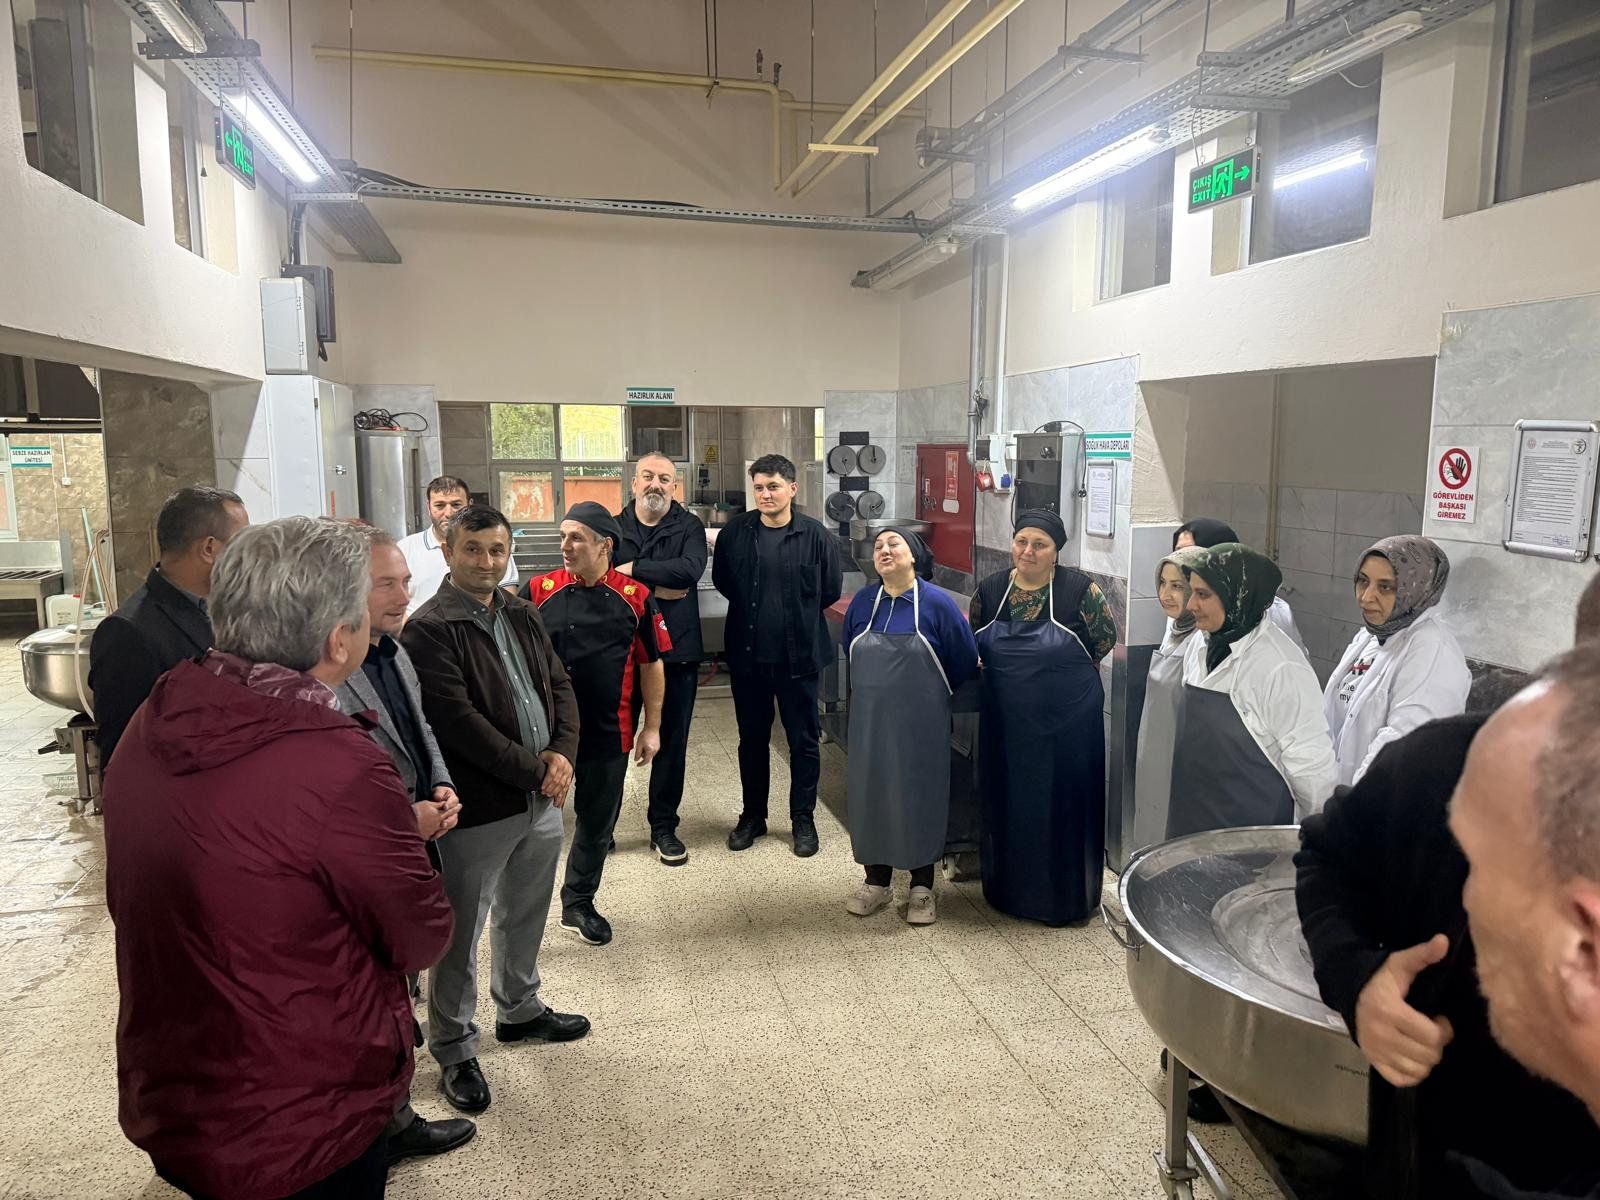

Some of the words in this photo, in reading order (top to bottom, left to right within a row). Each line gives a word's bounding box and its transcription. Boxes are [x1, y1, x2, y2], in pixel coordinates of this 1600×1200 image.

[1193, 174, 1212, 192] ÇIKIŞ
[1192, 190, 1211, 204] EXIT
[629, 392, 655, 400] HAZIRLIK
[655, 392, 673, 400] ALANI
[1433, 491, 1474, 501] GÖREVLİDEN
[1439, 501, 1466, 510] BAŞKASI
